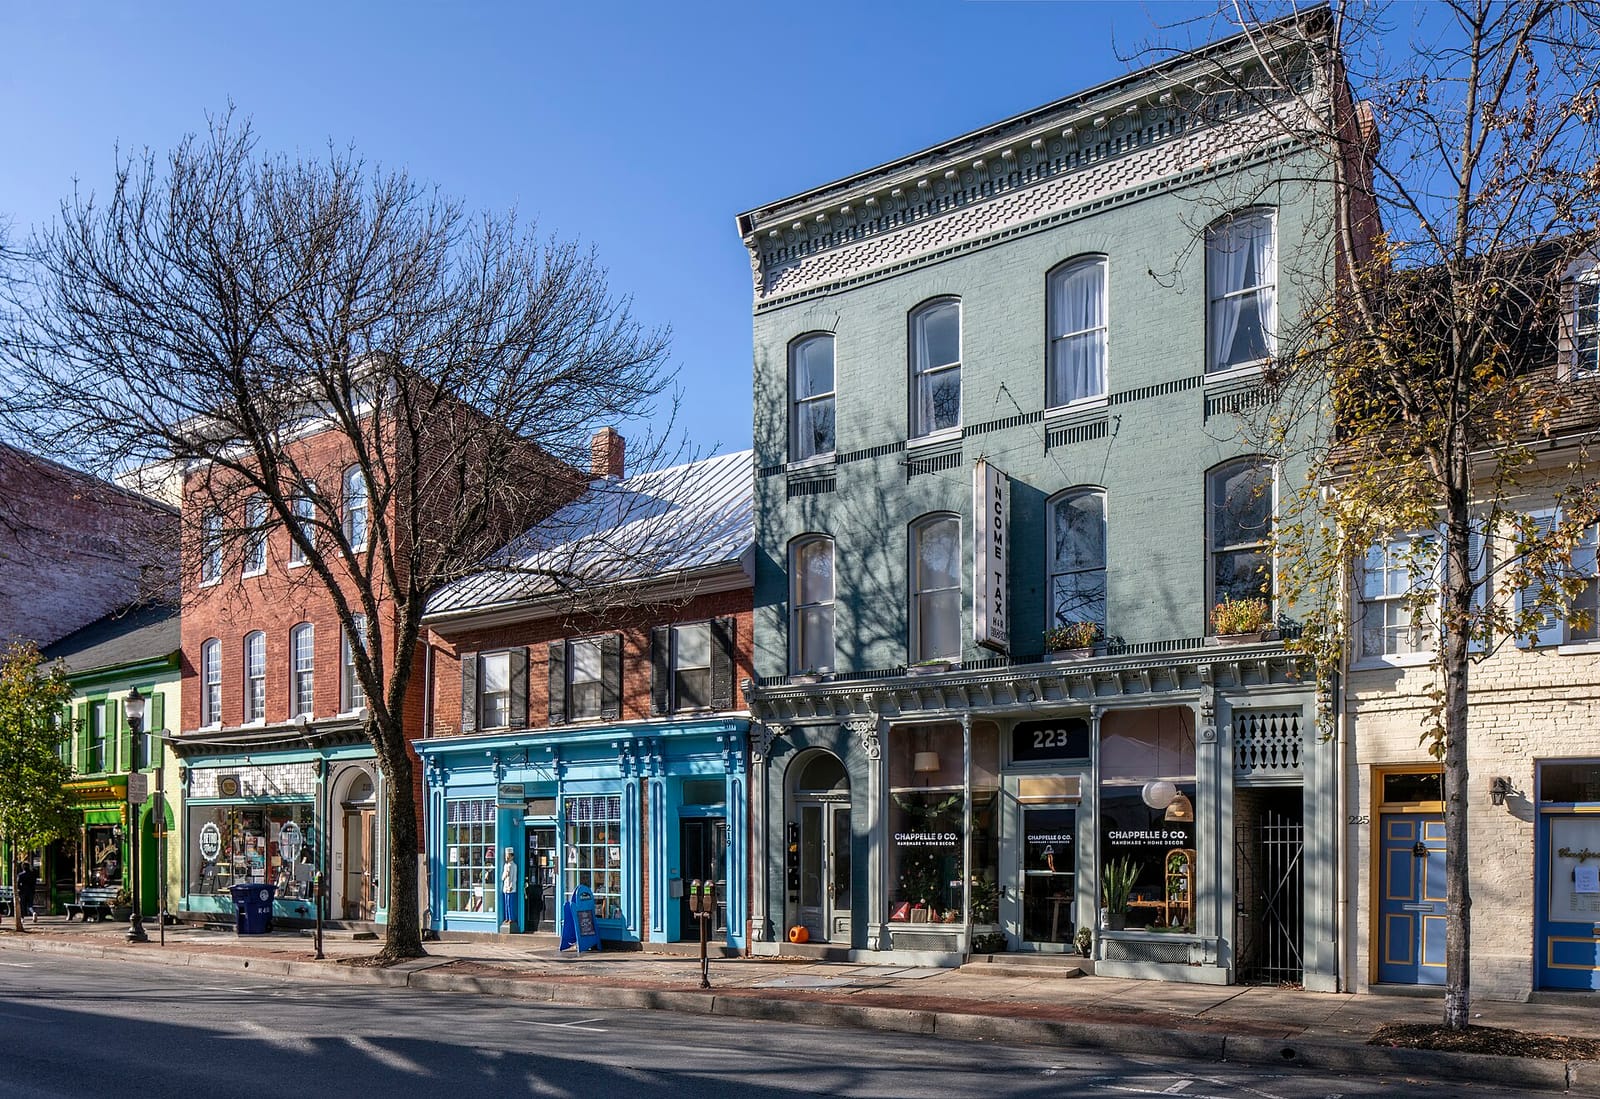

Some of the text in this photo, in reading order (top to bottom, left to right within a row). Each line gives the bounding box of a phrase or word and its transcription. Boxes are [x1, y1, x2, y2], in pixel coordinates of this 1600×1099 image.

[994, 472, 1003, 616] INCOME TAX
[992, 616, 1004, 629] H&R
[1033, 729, 1068, 748] 223
[1348, 815, 1370, 825] 225
[894, 832, 958, 841] CHAPPELLE & CO.
[1108, 831, 1188, 839] CHAPPELLE & CO.
